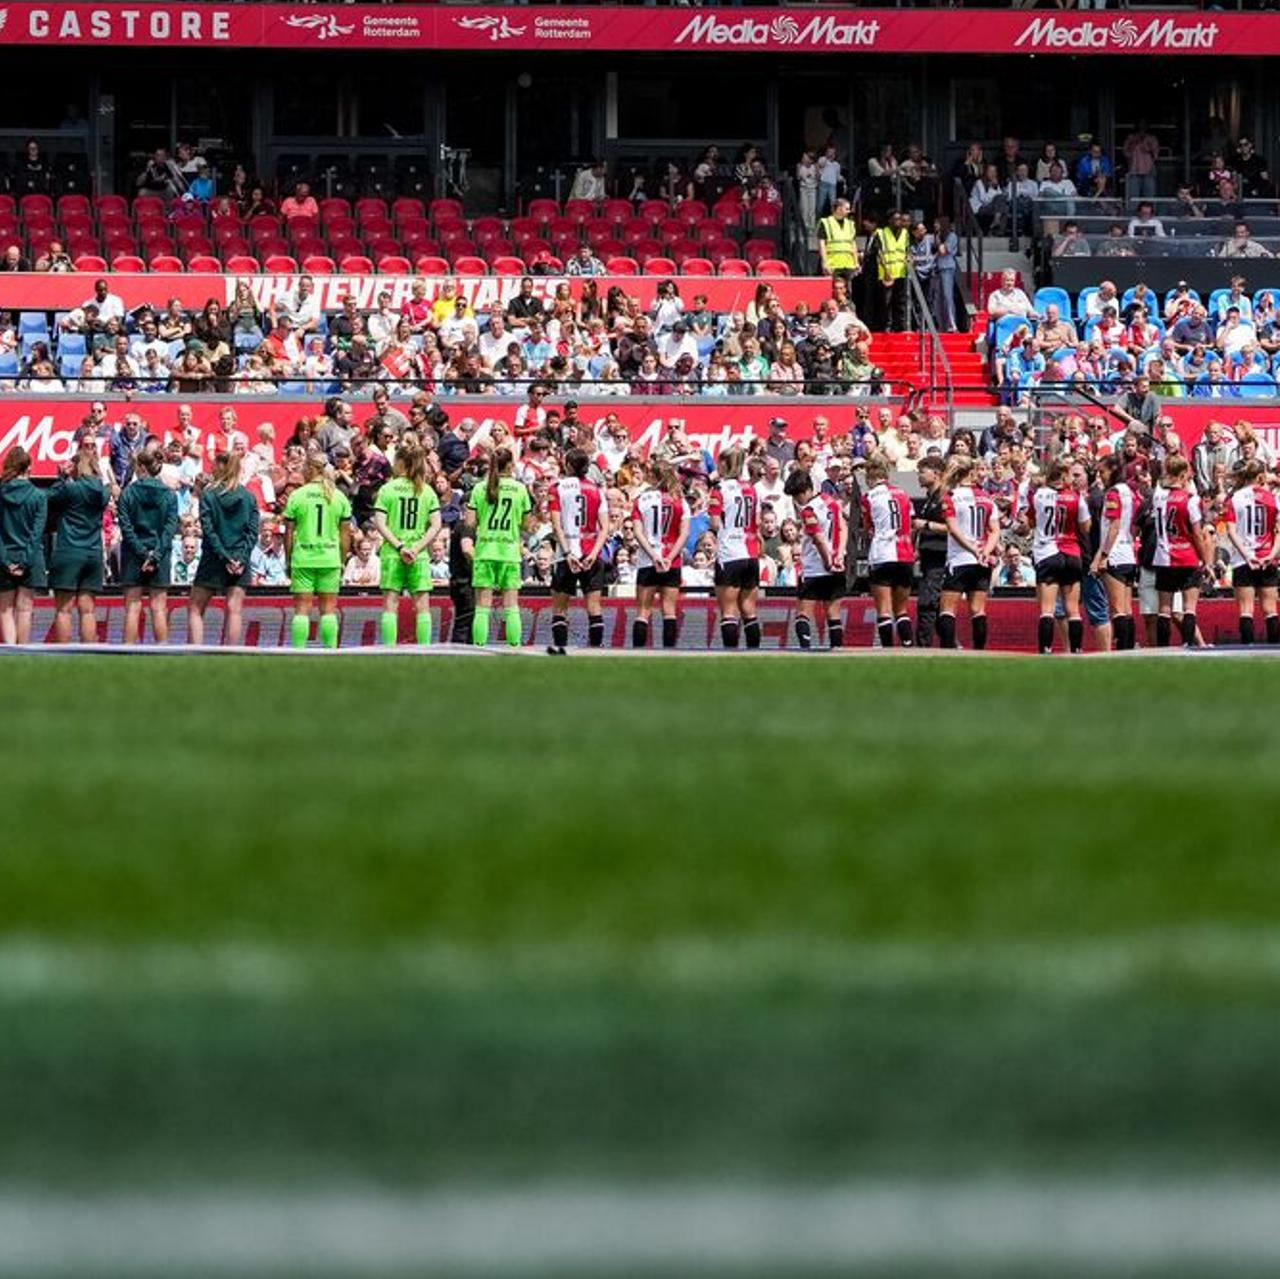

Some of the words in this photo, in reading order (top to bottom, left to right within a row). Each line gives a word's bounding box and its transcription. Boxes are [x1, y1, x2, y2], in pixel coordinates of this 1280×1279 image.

[28, 9, 231, 40] CASTORE
[363, 15, 419, 26] Gemeente
[363, 26, 421, 37] Rotterdam
[534, 16, 590, 27] Gemeente
[534, 27, 592, 39] Rotterdam
[674, 14, 769, 45] Media
[793, 15, 880, 45] Markt
[1013, 17, 1108, 47] Media
[1133, 18, 1219, 48] Markt
[315, 503, 324, 537] 1
[398, 496, 418, 530] 18
[574, 494, 587, 527] 3
[650, 504, 674, 537] 17
[968, 504, 987, 540] 10
